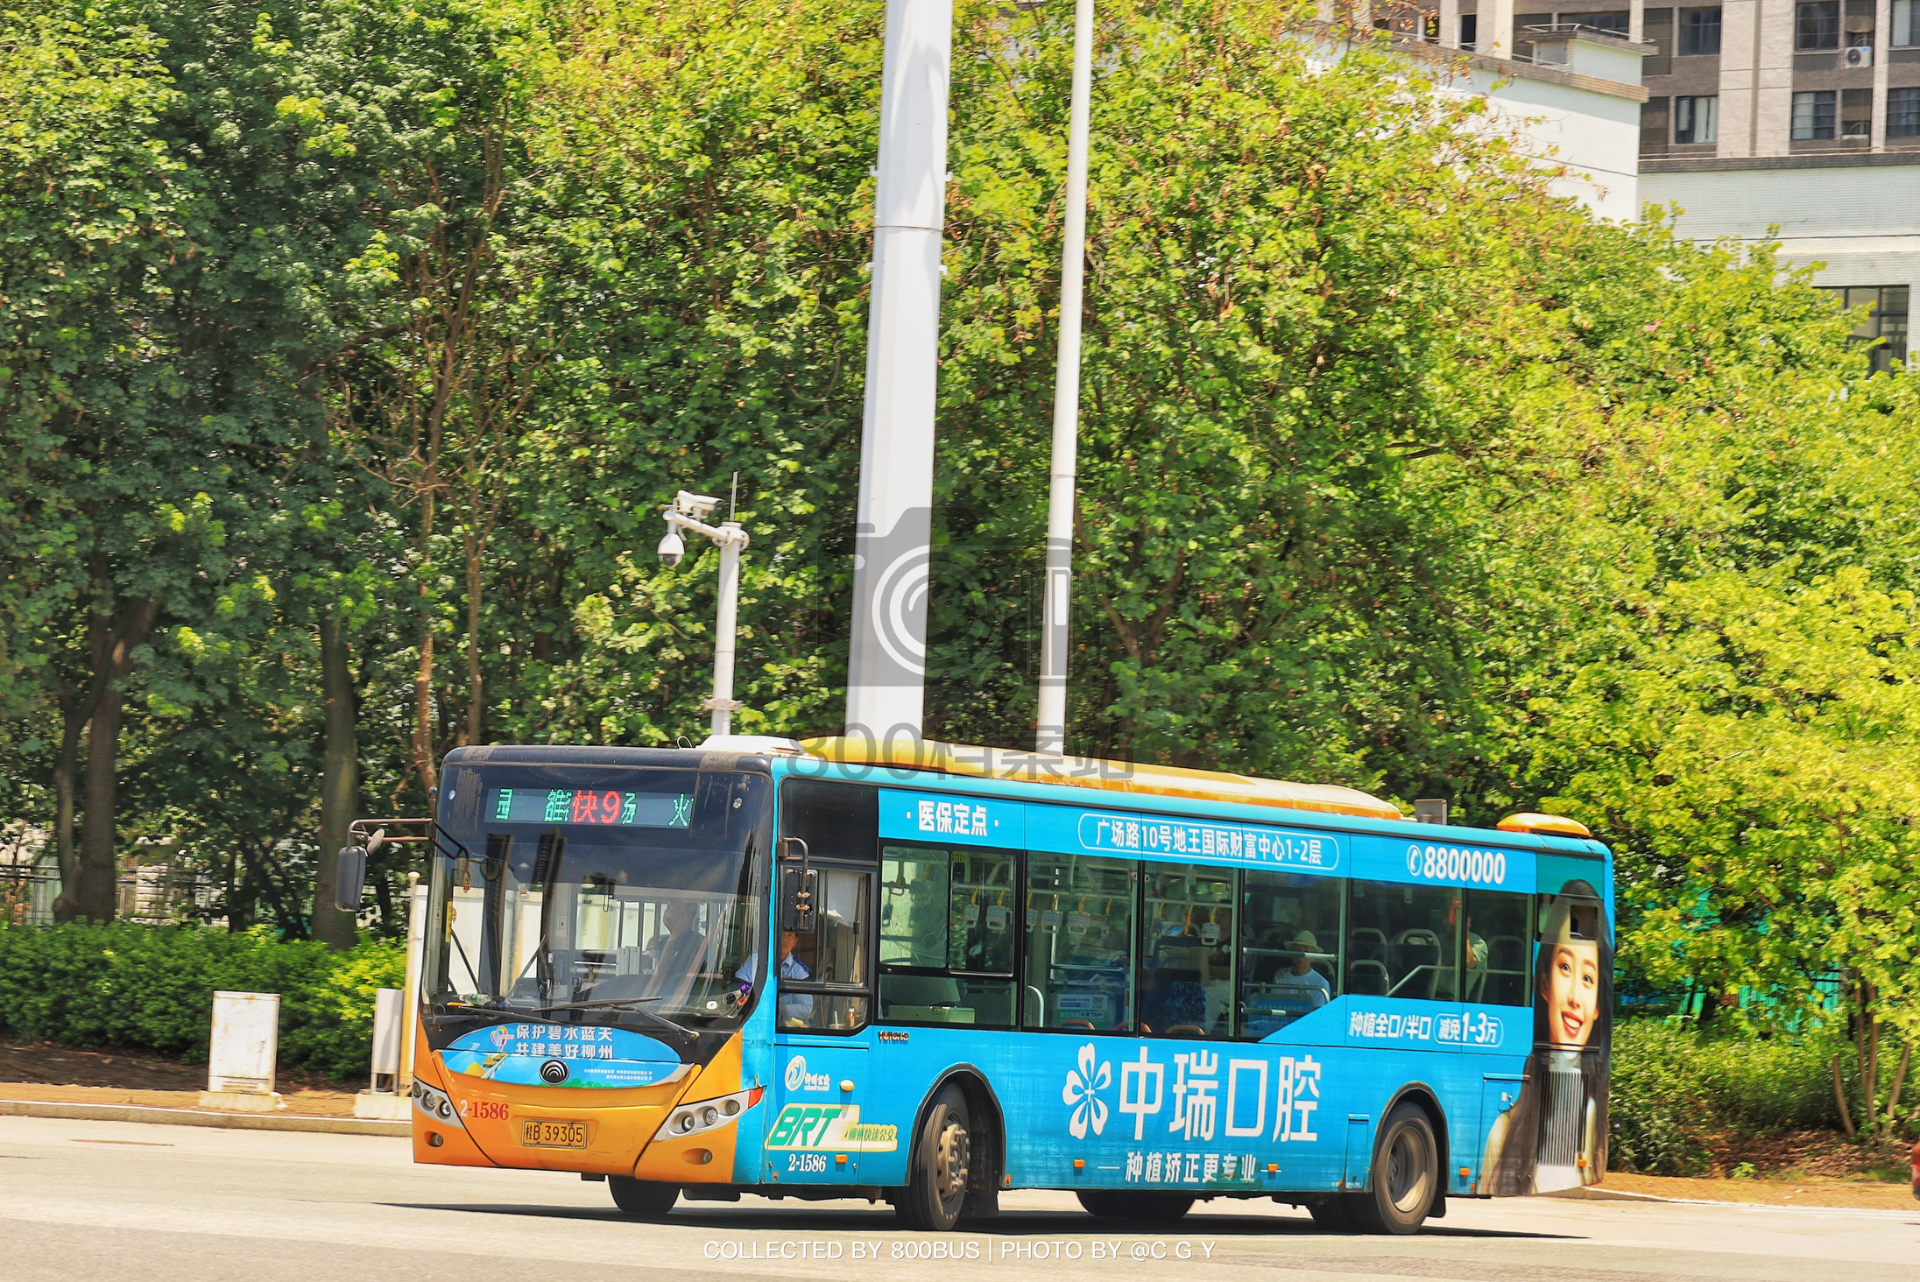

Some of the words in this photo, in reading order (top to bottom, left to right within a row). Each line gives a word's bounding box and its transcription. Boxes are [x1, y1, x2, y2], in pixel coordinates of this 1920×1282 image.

[918, 800, 988, 836] 医保定点
[1096, 819, 1322, 866] 广场路10号地王国际财富中心1-2层
[1423, 846, 1506, 885] 8800000
[516, 1024, 614, 1042] 保护碧水蓝天
[515, 1042, 614, 1060] 共建美好柳州
[460, 1099, 509, 1121] 2-1586
[1119, 1046, 1321, 1143] 中瑞口腔
[768, 1107, 843, 1147] BRT
[788, 1153, 827, 1172] 2-1586
[1125, 1151, 1257, 1183] 种植矫正更专业
